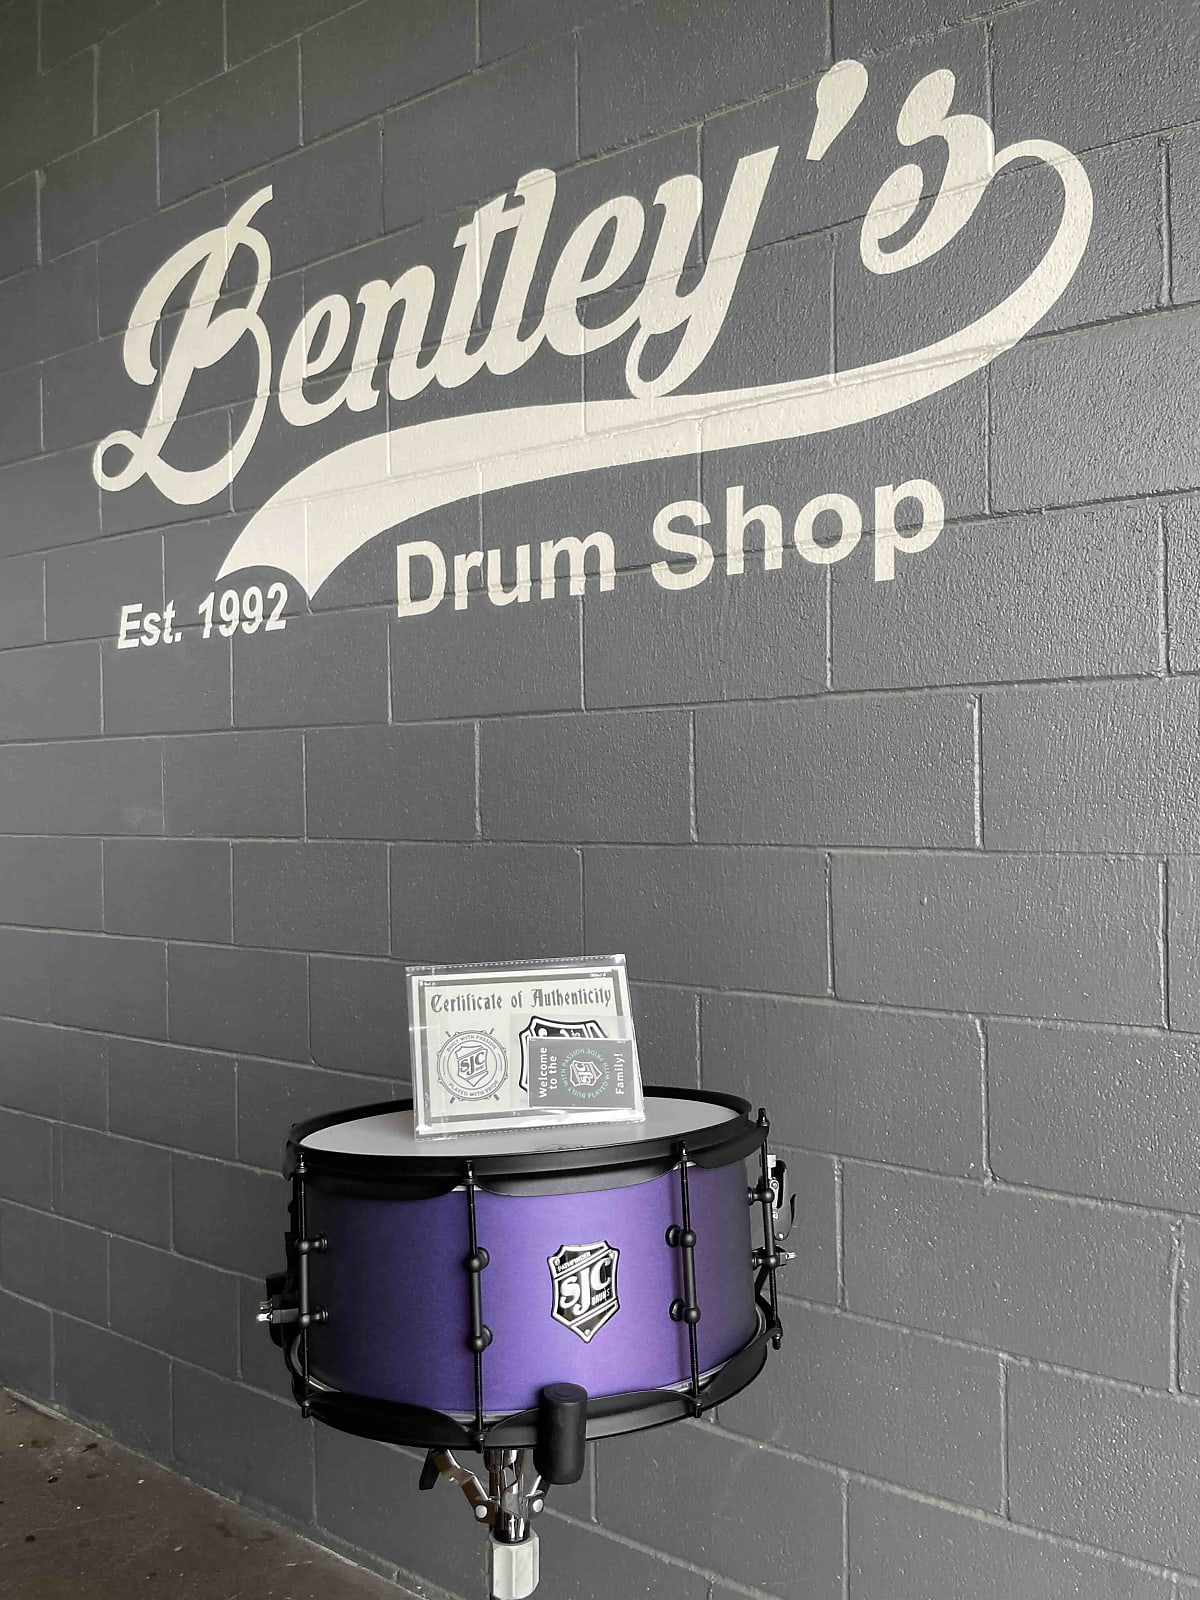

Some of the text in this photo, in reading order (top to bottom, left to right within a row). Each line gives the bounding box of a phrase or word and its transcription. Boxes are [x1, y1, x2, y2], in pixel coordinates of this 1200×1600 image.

[91, 58, 997, 506] Bentley's
[396, 479, 946, 618] Drum Shop
[117, 582, 288, 649] Est. 1992
[430, 987, 611, 1013] Certificate of Authenticity
[460, 1052, 485, 1076] SJC
[538, 1047, 548, 1098] Welcome
[548, 1055, 558, 1090] to the
[613, 1053, 625, 1095] Family!
[560, 1257, 611, 1315] SJC
